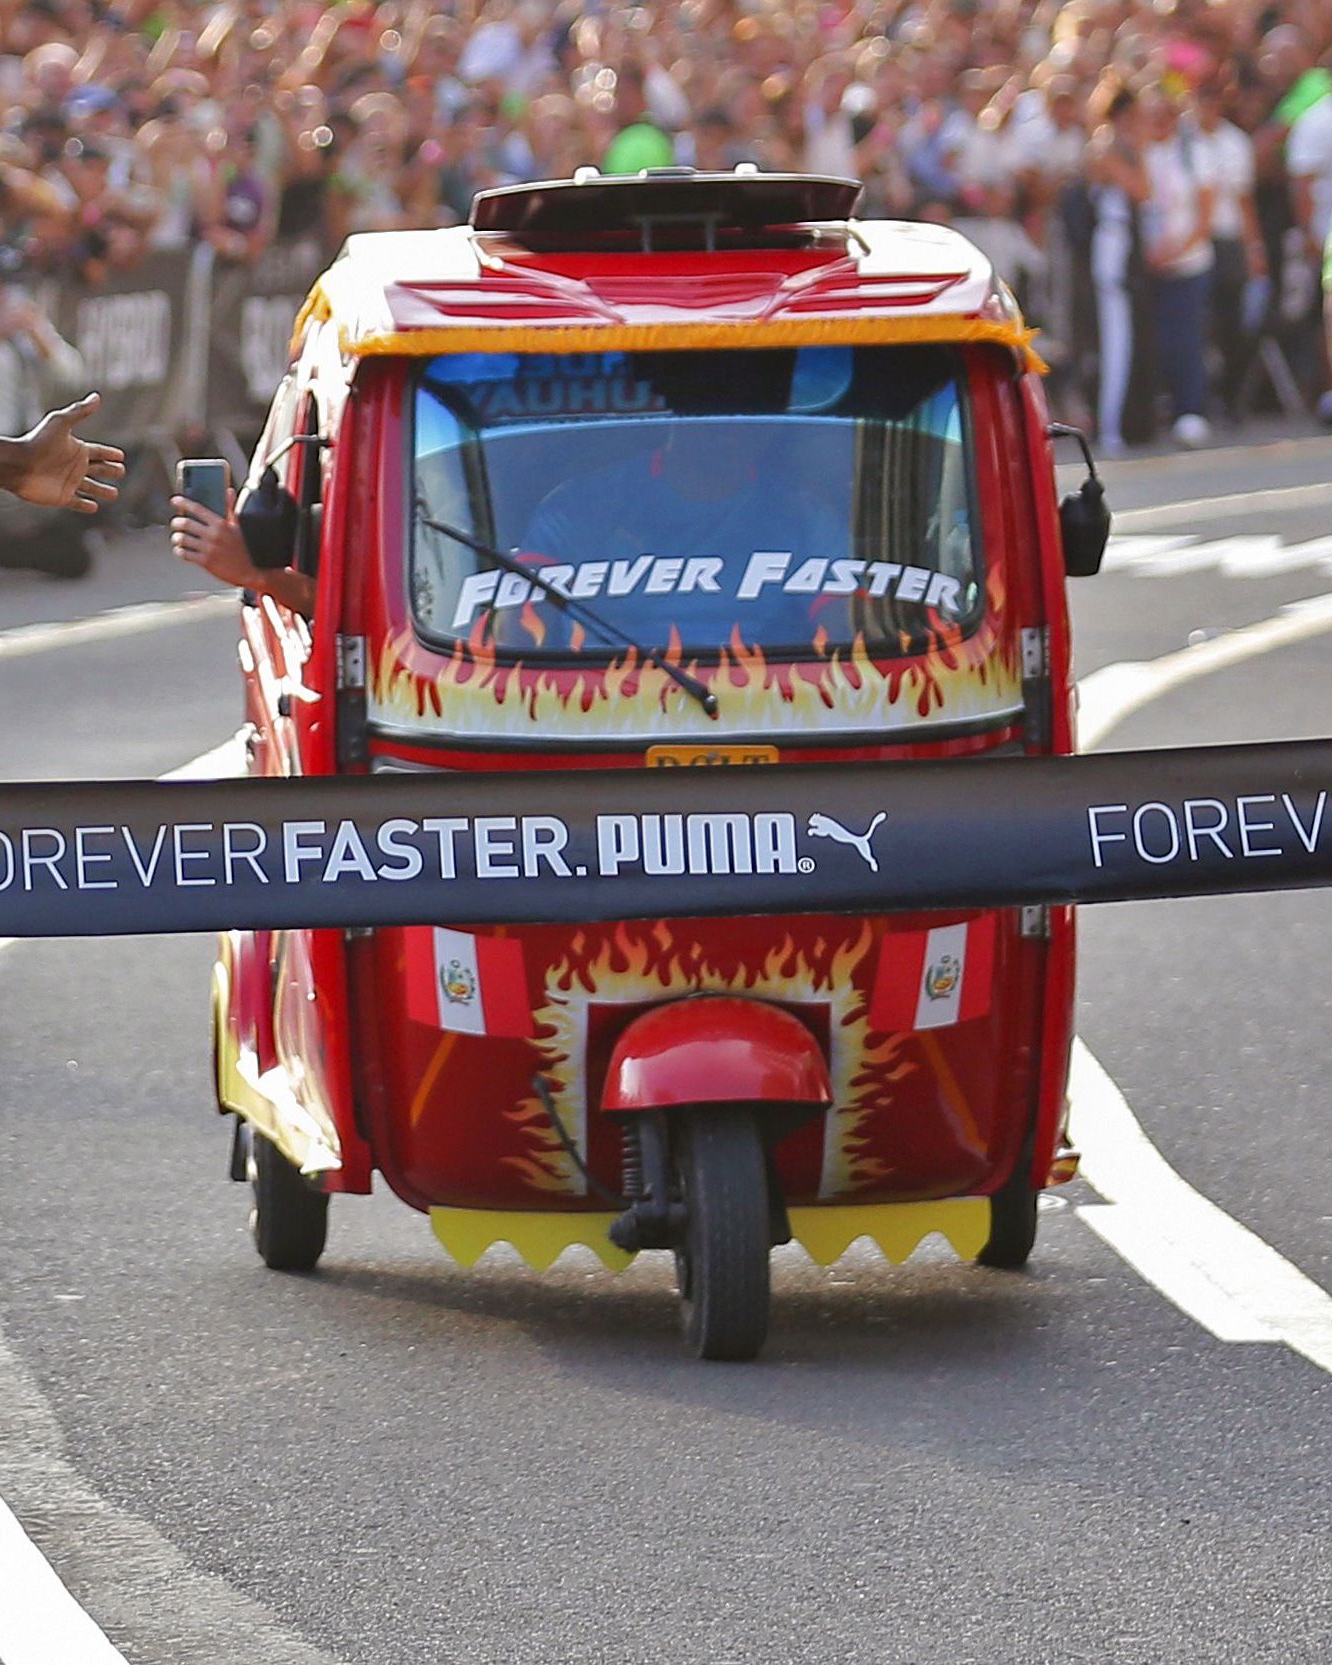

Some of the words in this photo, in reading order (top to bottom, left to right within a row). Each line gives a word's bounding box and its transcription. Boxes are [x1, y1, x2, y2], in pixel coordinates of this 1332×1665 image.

[452, 555, 722, 629] FOREVER
[736, 551, 961, 612] FASTER
[1088, 790, 1327, 868] FOREV
